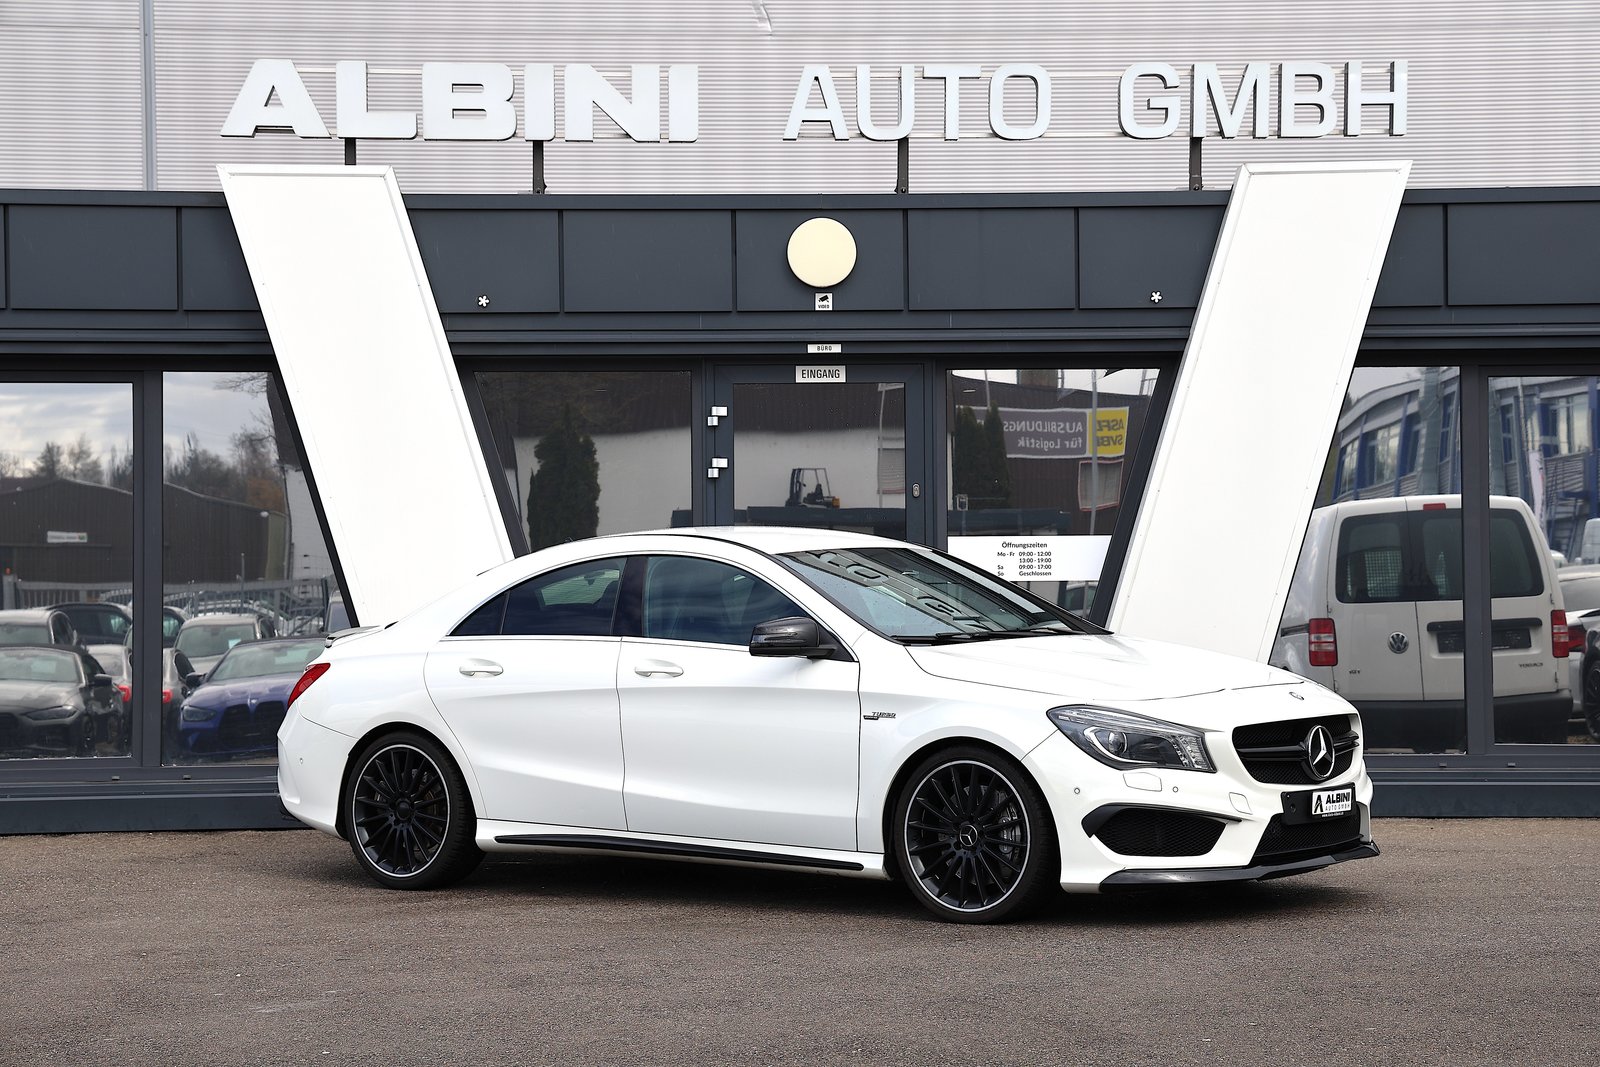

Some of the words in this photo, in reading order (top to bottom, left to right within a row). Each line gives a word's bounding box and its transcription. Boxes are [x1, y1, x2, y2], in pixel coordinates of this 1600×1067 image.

[220, 58, 699, 143] ALBINI
[782, 62, 1052, 141] AUTO
[1118, 60, 1409, 140] GMBH
[801, 369, 840, 378] EINGANG
[1326, 792, 1350, 804] ALBINI
